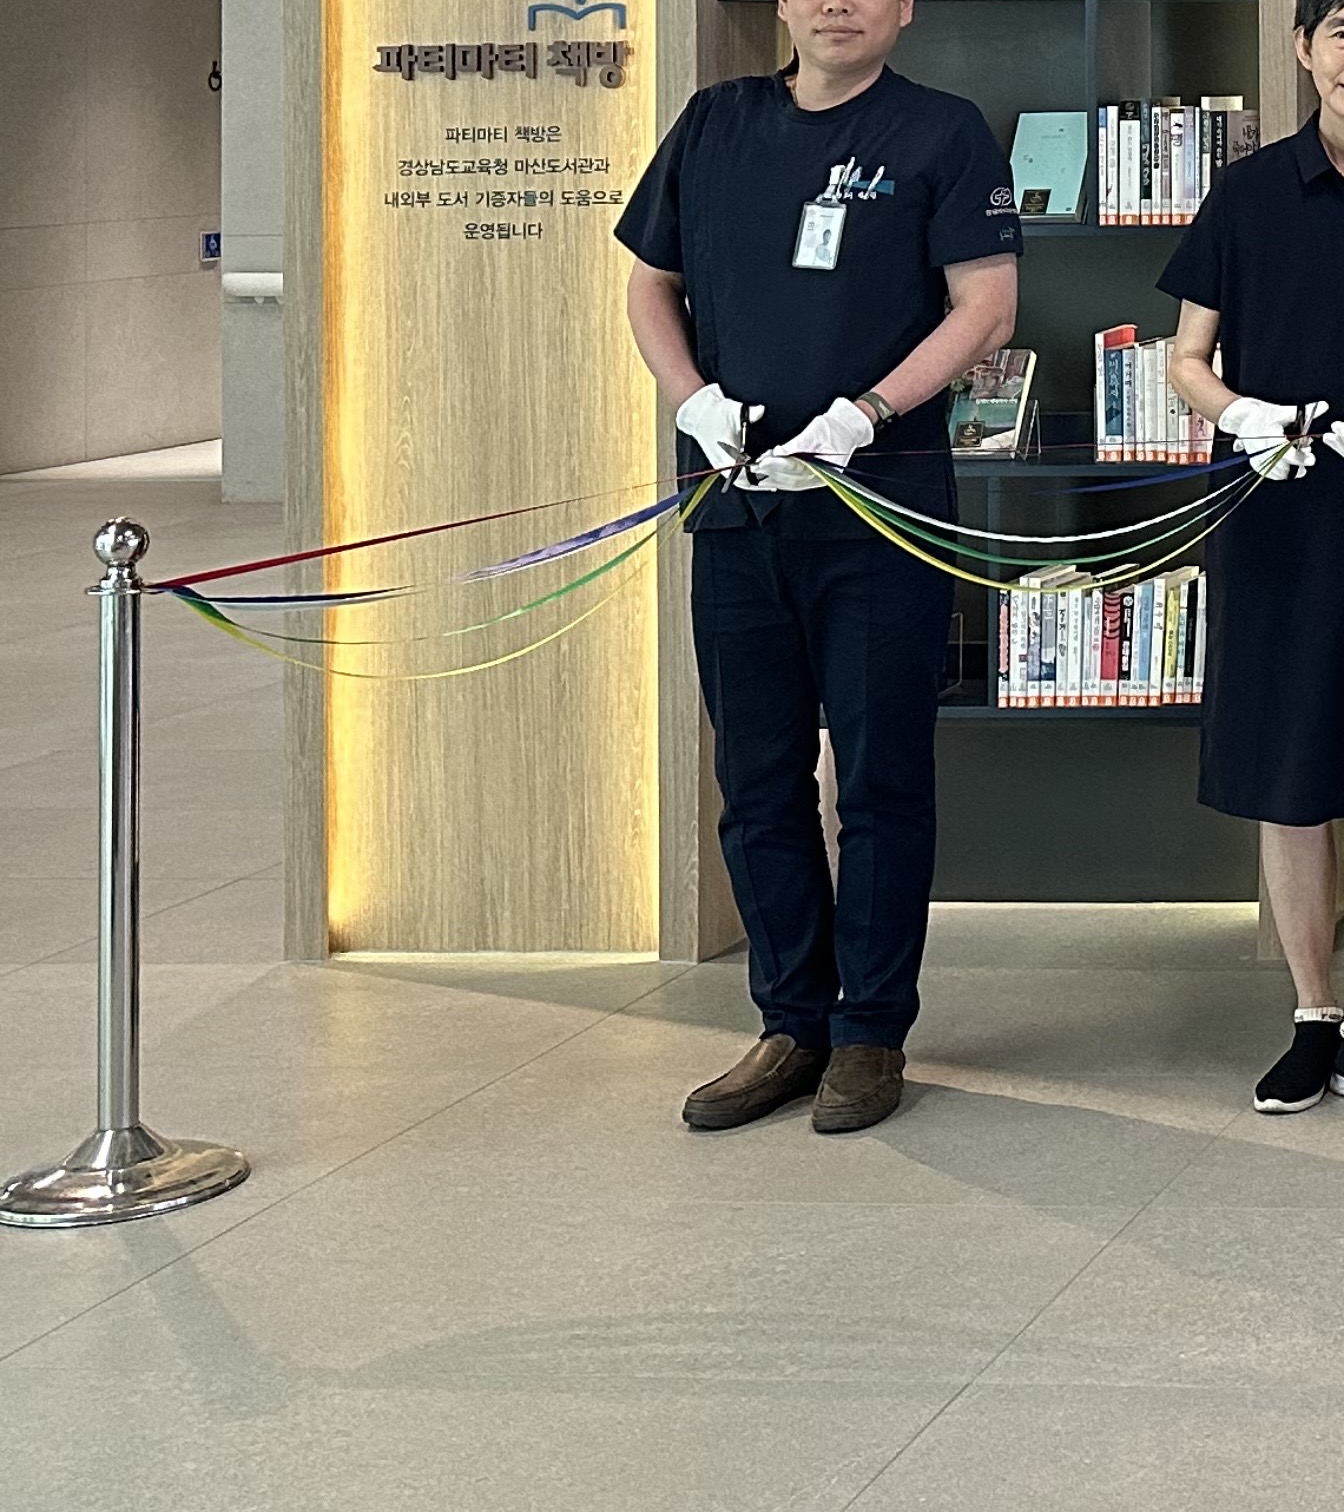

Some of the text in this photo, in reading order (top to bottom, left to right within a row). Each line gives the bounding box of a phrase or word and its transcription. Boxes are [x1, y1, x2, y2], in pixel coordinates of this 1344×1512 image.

[372, 40, 635, 89] 파티마티 책방
[445, 126, 562, 143] 파티마티 책방은
[398, 157, 610, 176] 경상남도교육청 마산도서관과
[384, 190, 624, 208] 내외부 도서 기증자들의 도움으로
[463, 222, 544, 239] 운영됩니다
